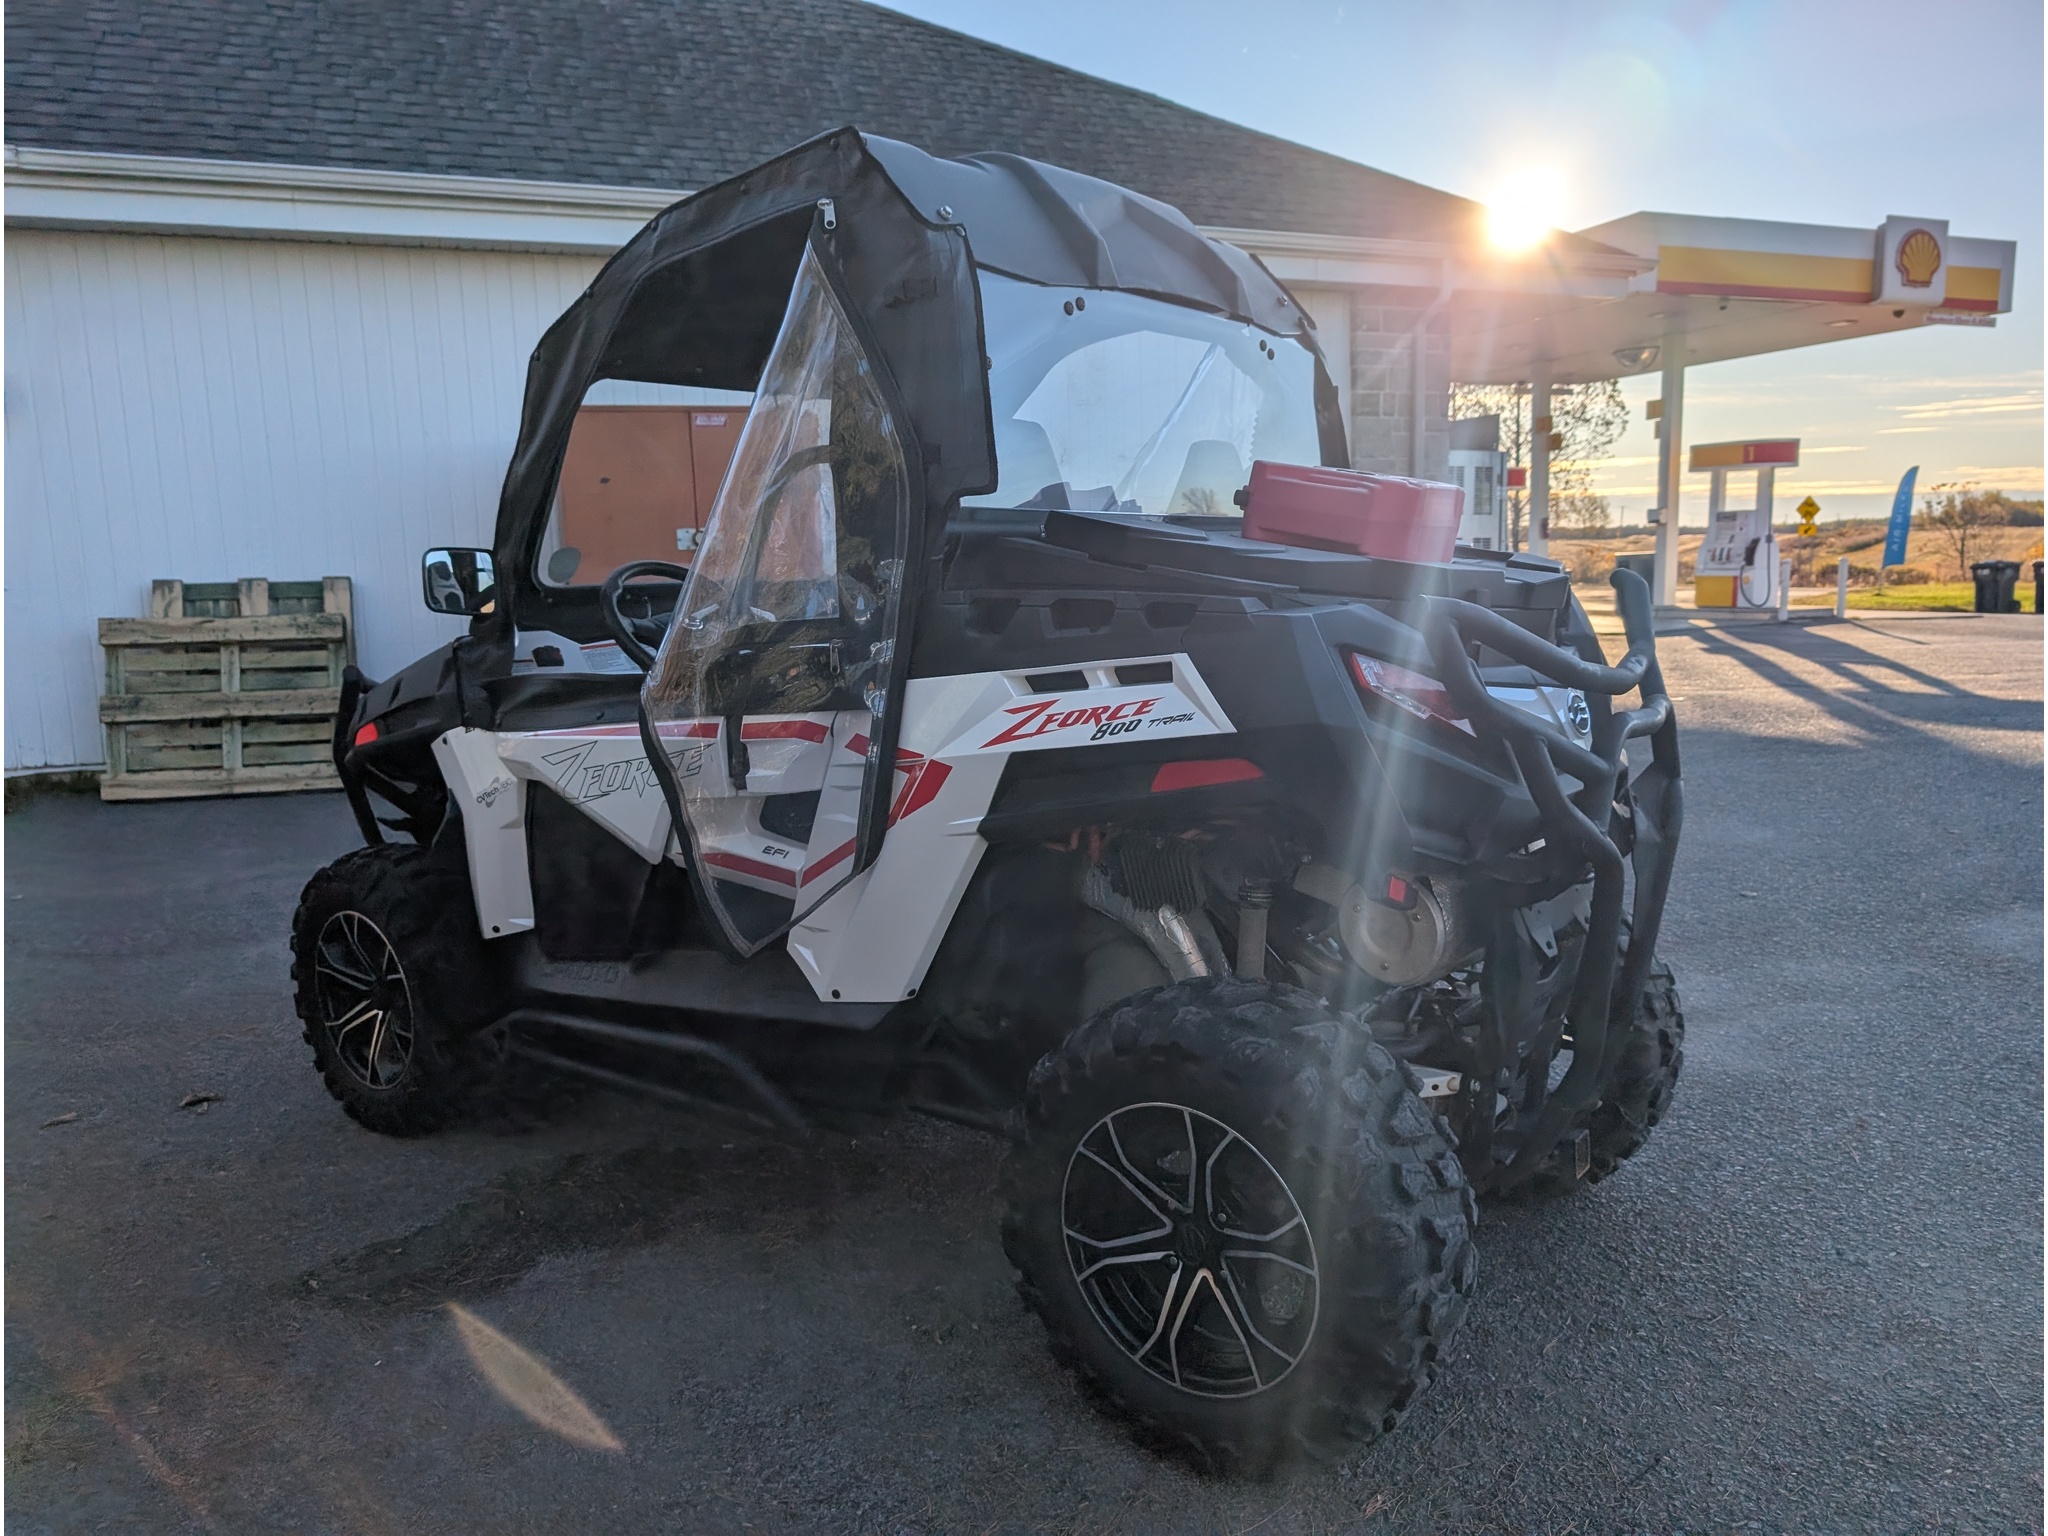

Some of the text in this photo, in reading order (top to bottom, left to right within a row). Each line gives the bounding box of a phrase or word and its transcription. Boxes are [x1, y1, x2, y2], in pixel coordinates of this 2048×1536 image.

[978, 697, 1163, 749] ZFORCE
[1090, 712, 1195, 740] 800 TRAIL
[762, 845, 790, 860] EFI
